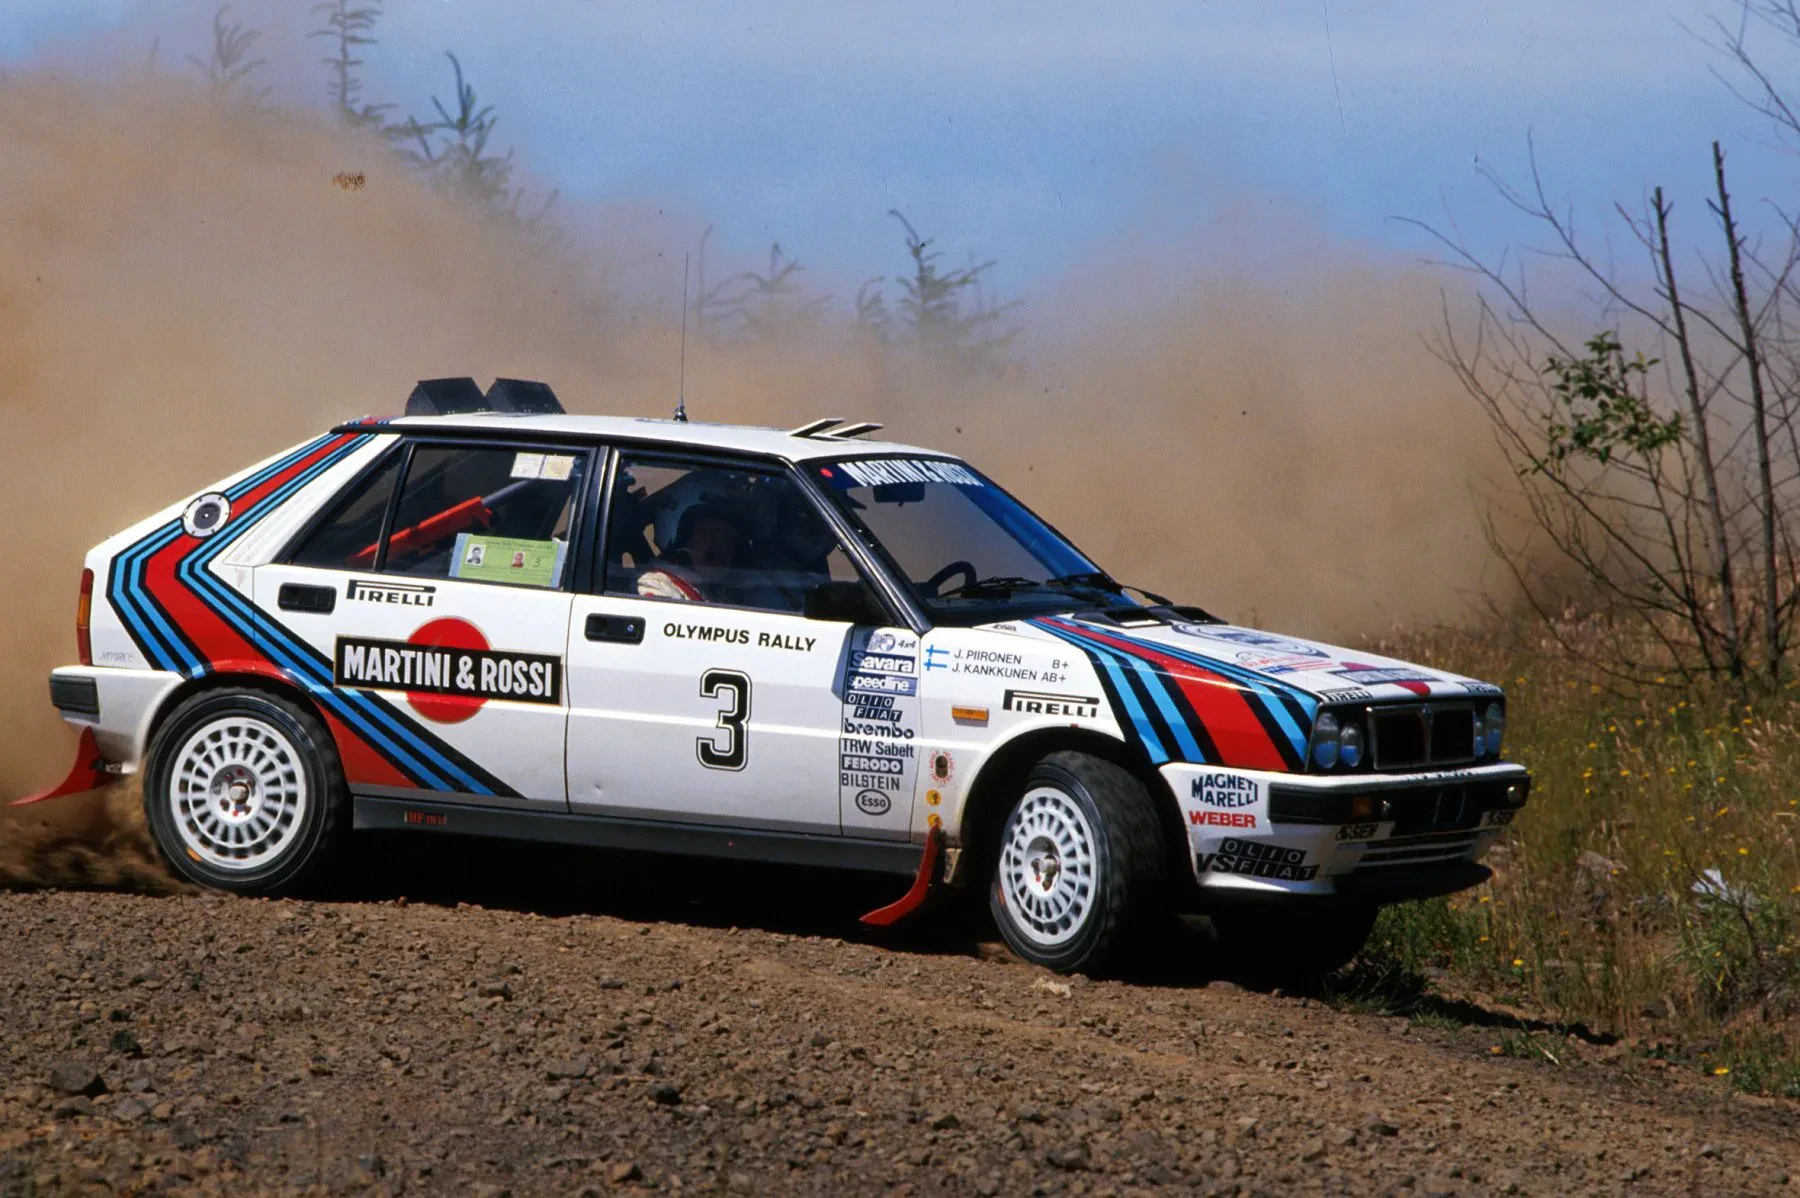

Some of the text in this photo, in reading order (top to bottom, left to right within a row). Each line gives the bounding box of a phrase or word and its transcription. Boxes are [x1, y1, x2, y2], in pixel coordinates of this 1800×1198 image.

[346, 579, 437, 607] PIRELLI
[663, 622, 817, 652] OLYMPUS RALLY
[954, 649, 1069, 669] J. PIIRONEN B+
[343, 645, 552, 697] MARTINI & ROSSI
[952, 662, 1067, 683] J. KANKKUNEN AB+
[847, 695, 892, 707] OLIO
[1003, 689, 1100, 718] PIRELLI
[1316, 687, 1373, 702] PIRELLI
[696, 668, 752, 772] 3
[856, 708, 900, 720] FIAT
[844, 718, 914, 739] brembo
[842, 738, 914, 758] TRW Sabelt
[844, 757, 901, 773] FERODO
[842, 773, 900, 791] BILSTEIN
[1191, 773, 1258, 798] MAGNETI
[1191, 783, 1258, 808] MARELLI
[1189, 811, 1256, 828] WEBER
[1224, 840, 1301, 863] OLIO
[1238, 862, 1313, 879] FIAT
